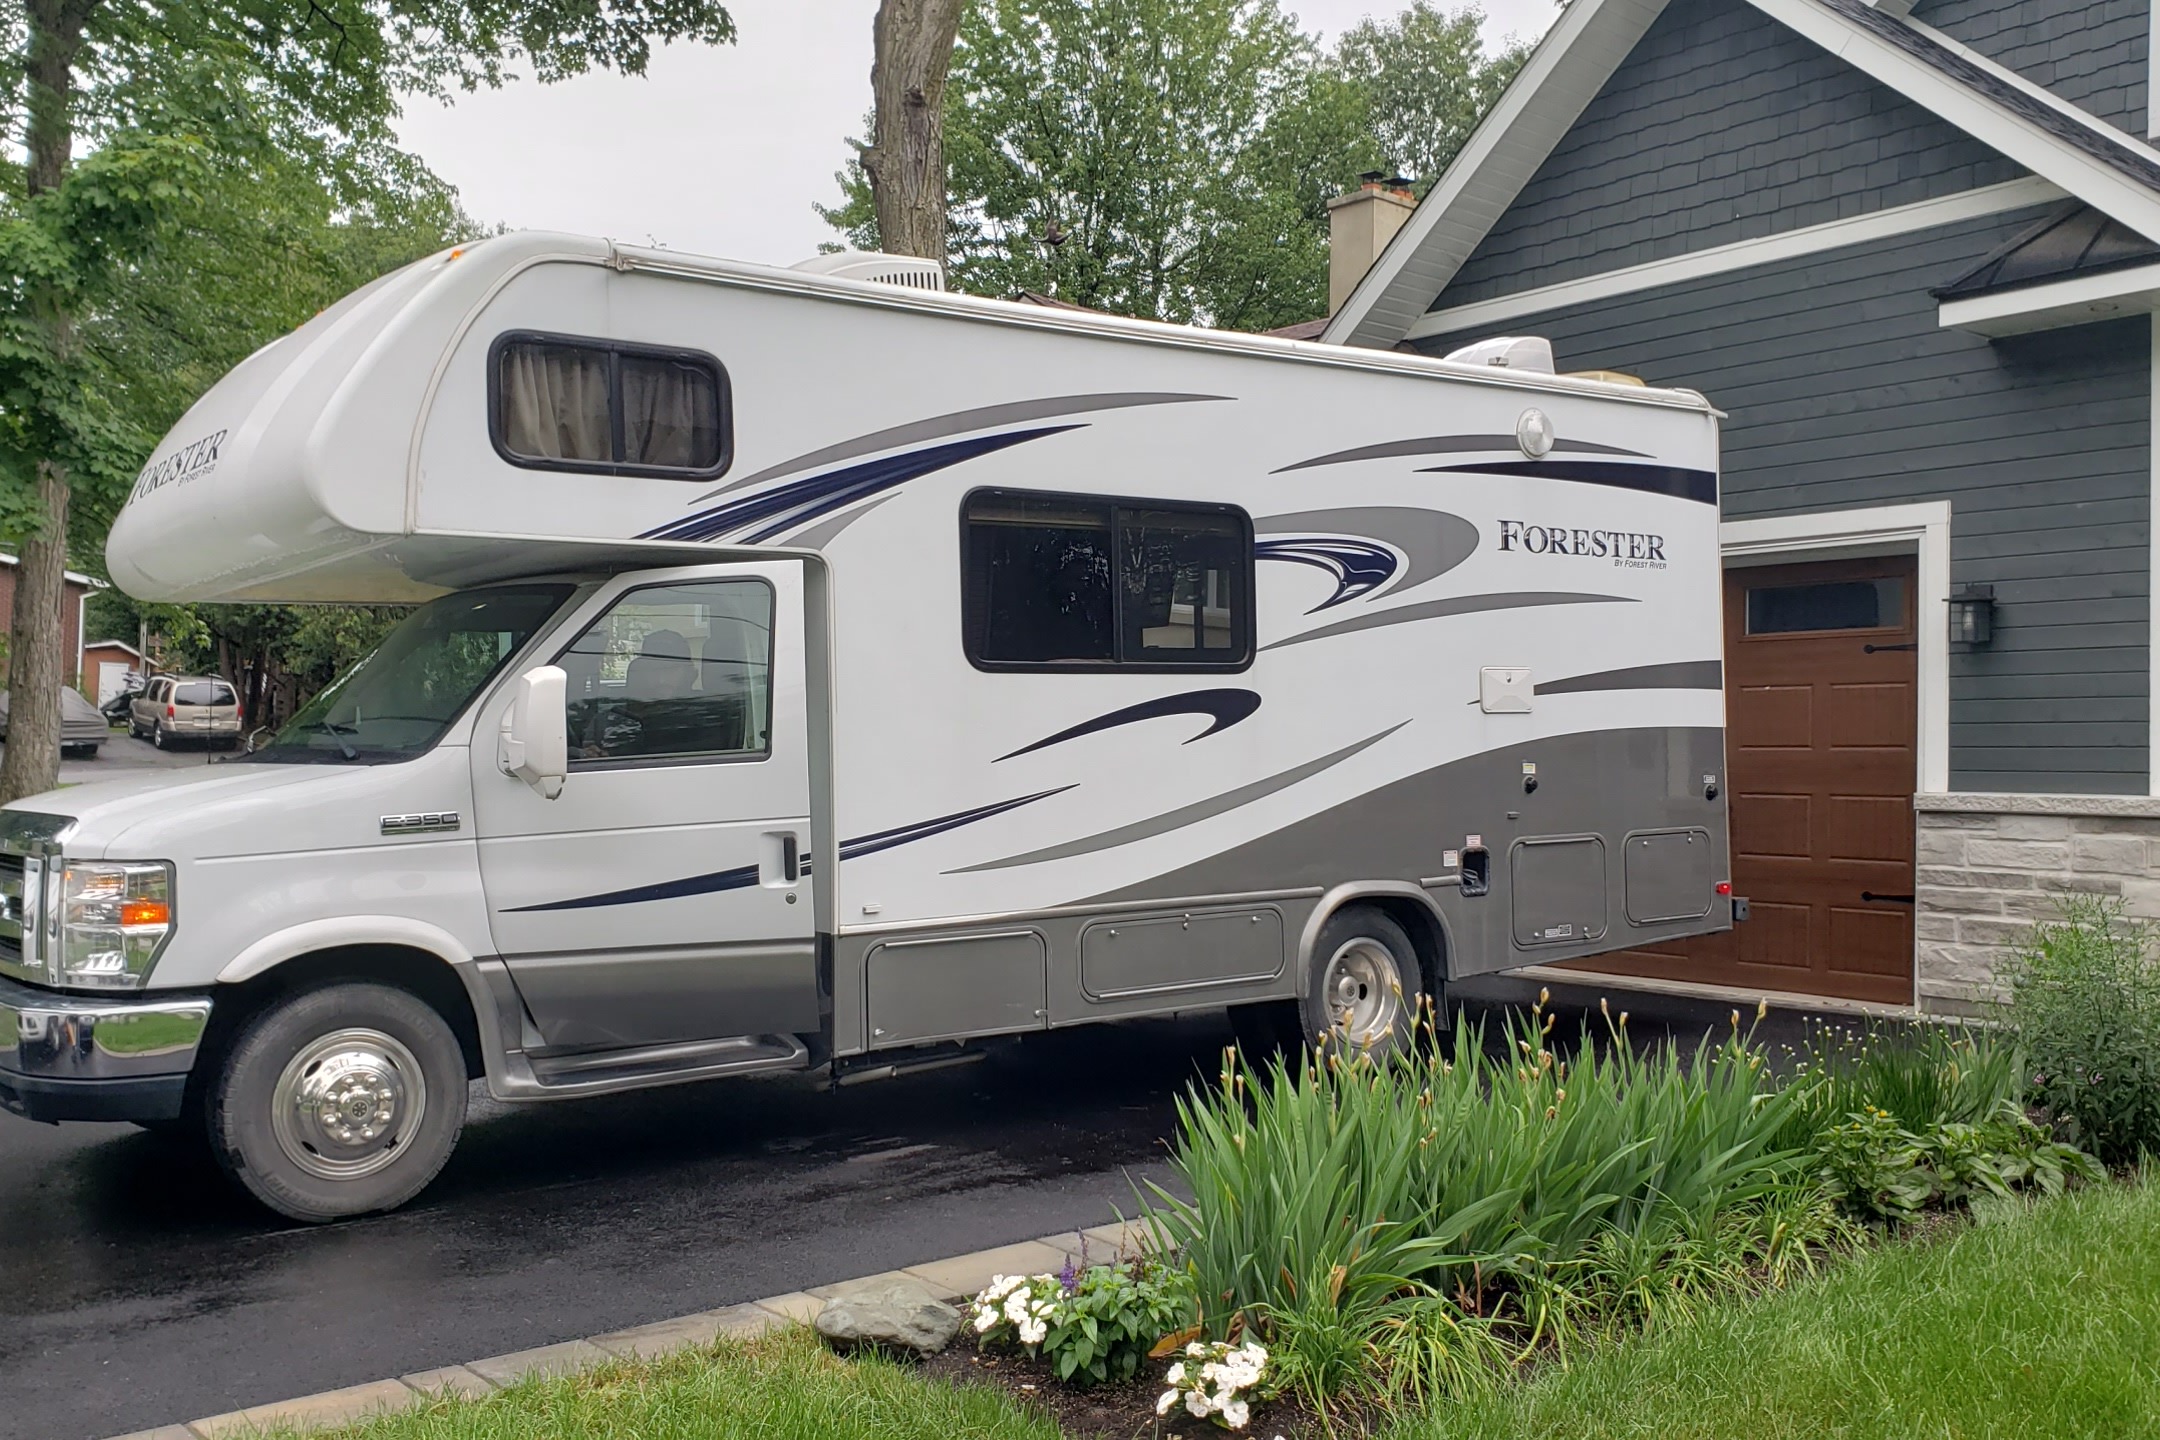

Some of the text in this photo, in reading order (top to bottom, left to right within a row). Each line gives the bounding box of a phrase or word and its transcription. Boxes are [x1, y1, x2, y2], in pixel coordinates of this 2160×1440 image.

[128, 429, 228, 507] FORESTER
[1497, 519, 1667, 561] FORESTER
[1614, 559, 1667, 570] BY FOREST RIVER
[382, 813, 458, 828] E-350
